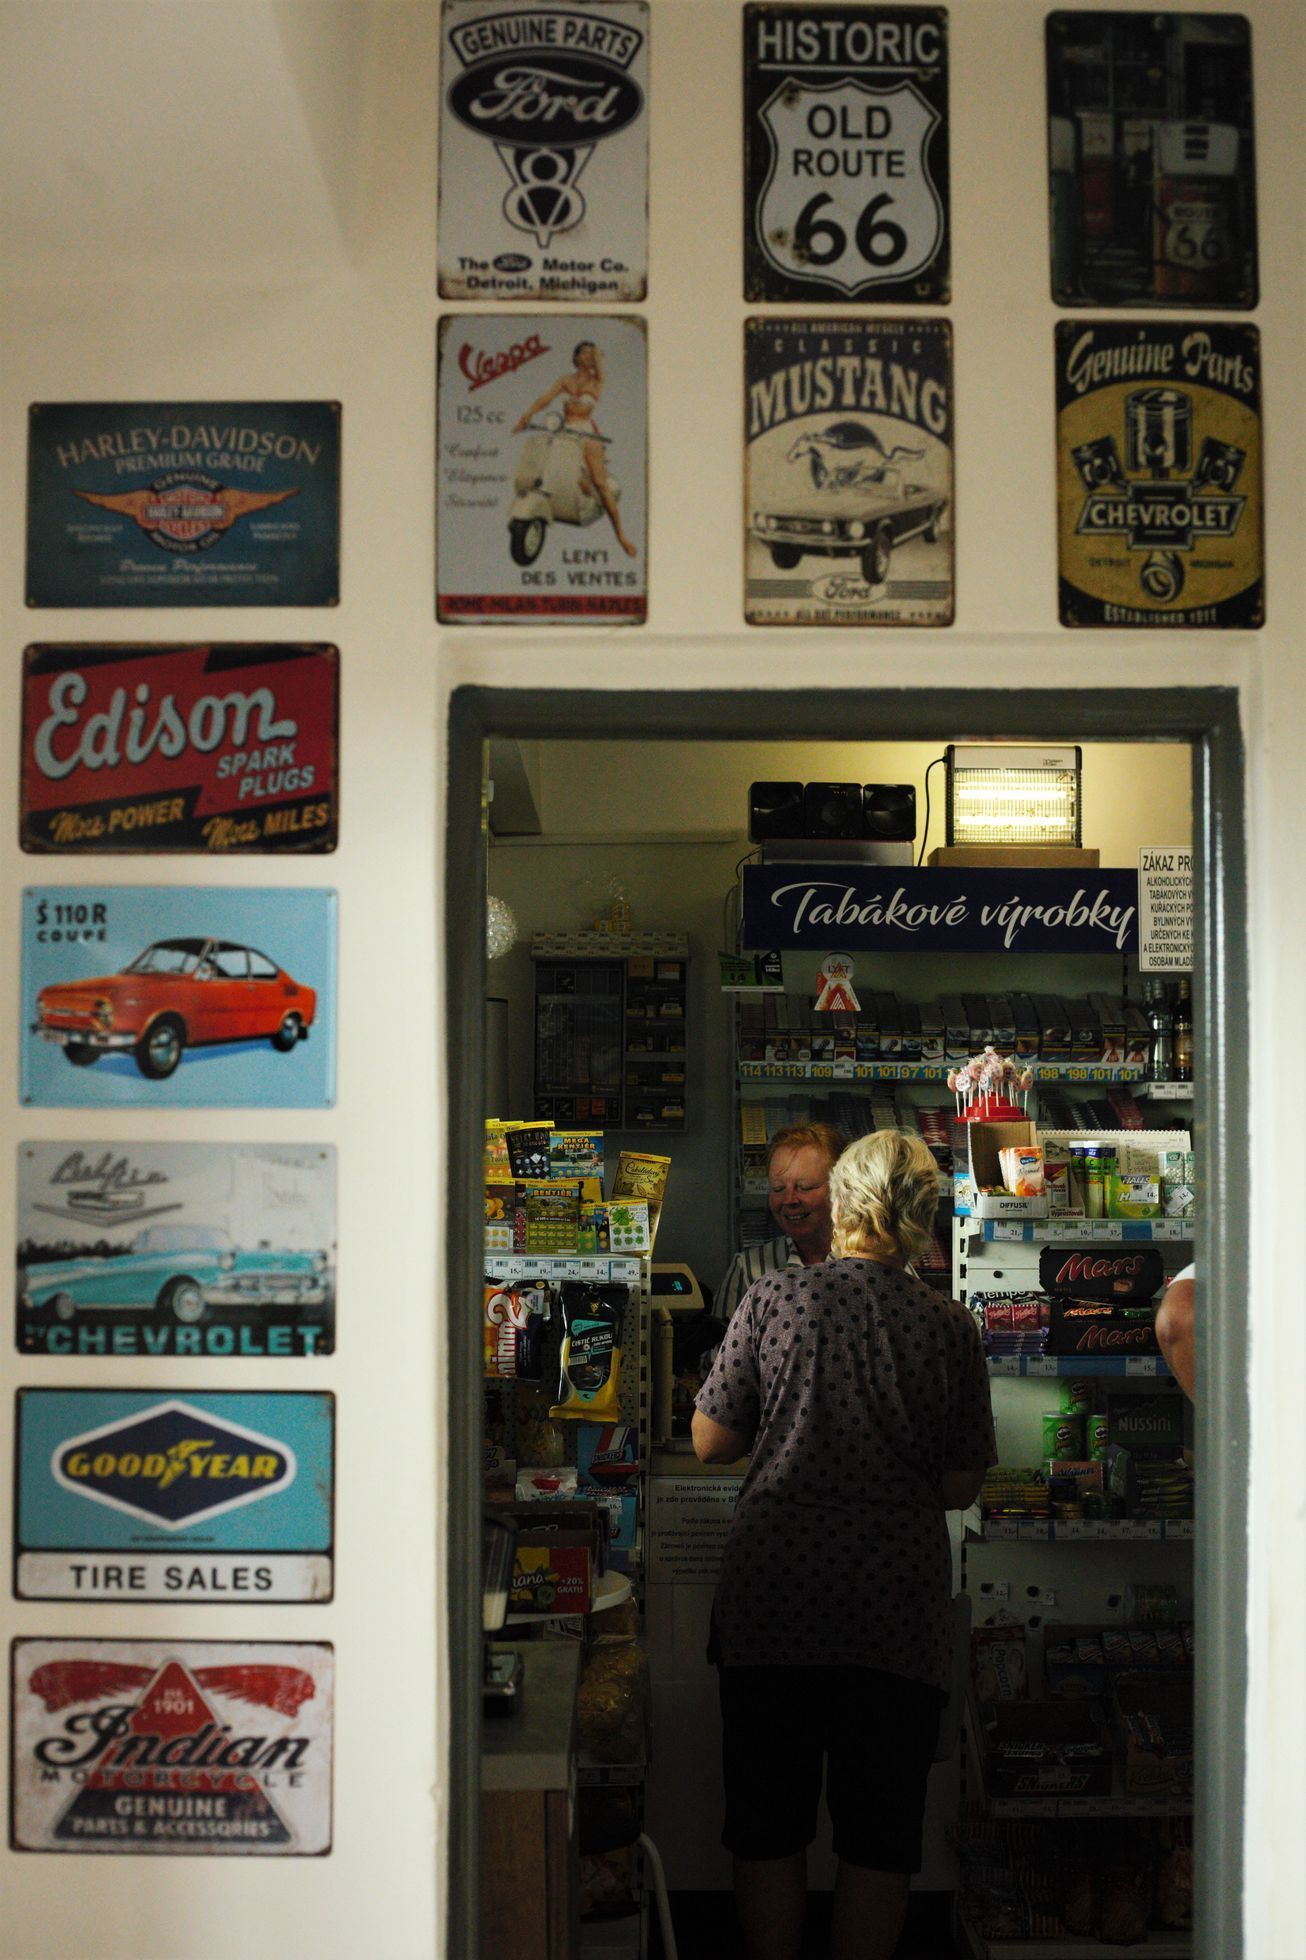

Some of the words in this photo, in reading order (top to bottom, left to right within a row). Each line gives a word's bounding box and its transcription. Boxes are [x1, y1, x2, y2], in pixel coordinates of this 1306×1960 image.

[461, 19, 557, 55] GENUINE
[563, 20, 634, 58] PARTS
[757, 20, 940, 63] HISTORIC
[469, 66, 621, 122] Ford
[807, 104, 892, 140] OLD
[792, 149, 906, 178] ROUTE
[793, 191, 908, 268] 66
[458, 257, 489, 271] The
[542, 258, 594, 272] Motor
[601, 258, 629, 272] Co.
[539, 278, 619, 294] Michigan
[459, 333, 551, 392] Vespa
[1066, 330, 1174, 393] Genuine
[1182, 332, 1254, 393] Parts
[751, 356, 948, 434] MUSTANG
[456, 405, 483, 424] 125
[56, 425, 321, 468] HARLEY-DAVIDSON
[115, 453, 202, 474] PREMIUM
[206, 454, 267, 473] GRADE
[1090, 504, 1231, 526] CHEVROLET
[522, 572, 556, 586] DES
[567, 572, 637, 586] VENTES
[34, 672, 297, 779] Edison
[216, 744, 297, 778] SPARK
[238, 766, 315, 800] PLUGS
[108, 799, 185, 833] POWER
[263, 803, 330, 836] MILES
[1143, 851, 1174, 871] ZÁKAZ
[771, 881, 970, 934] Tabákové
[980, 888, 1136, 950] výrobky
[1123, 1176, 1150, 1184] HALLS
[1056, 1253, 1144, 1283] Mars
[46, 1325, 323, 1355] CHEVROLET
[1076, 1325, 1150, 1350] Mars
[69, 1566, 146, 1589] TIRE
[165, 1567, 273, 1590] SALES
[154, 1701, 195, 1715] 1901
[34, 1705, 310, 1770] Indian
[40, 1771, 304, 1788] MOTORCYCLE
[114, 1796, 227, 1818] GENUINE
[72, 1819, 127, 1835] PARTS
[154, 1820, 270, 1836] ACCESSORIES
